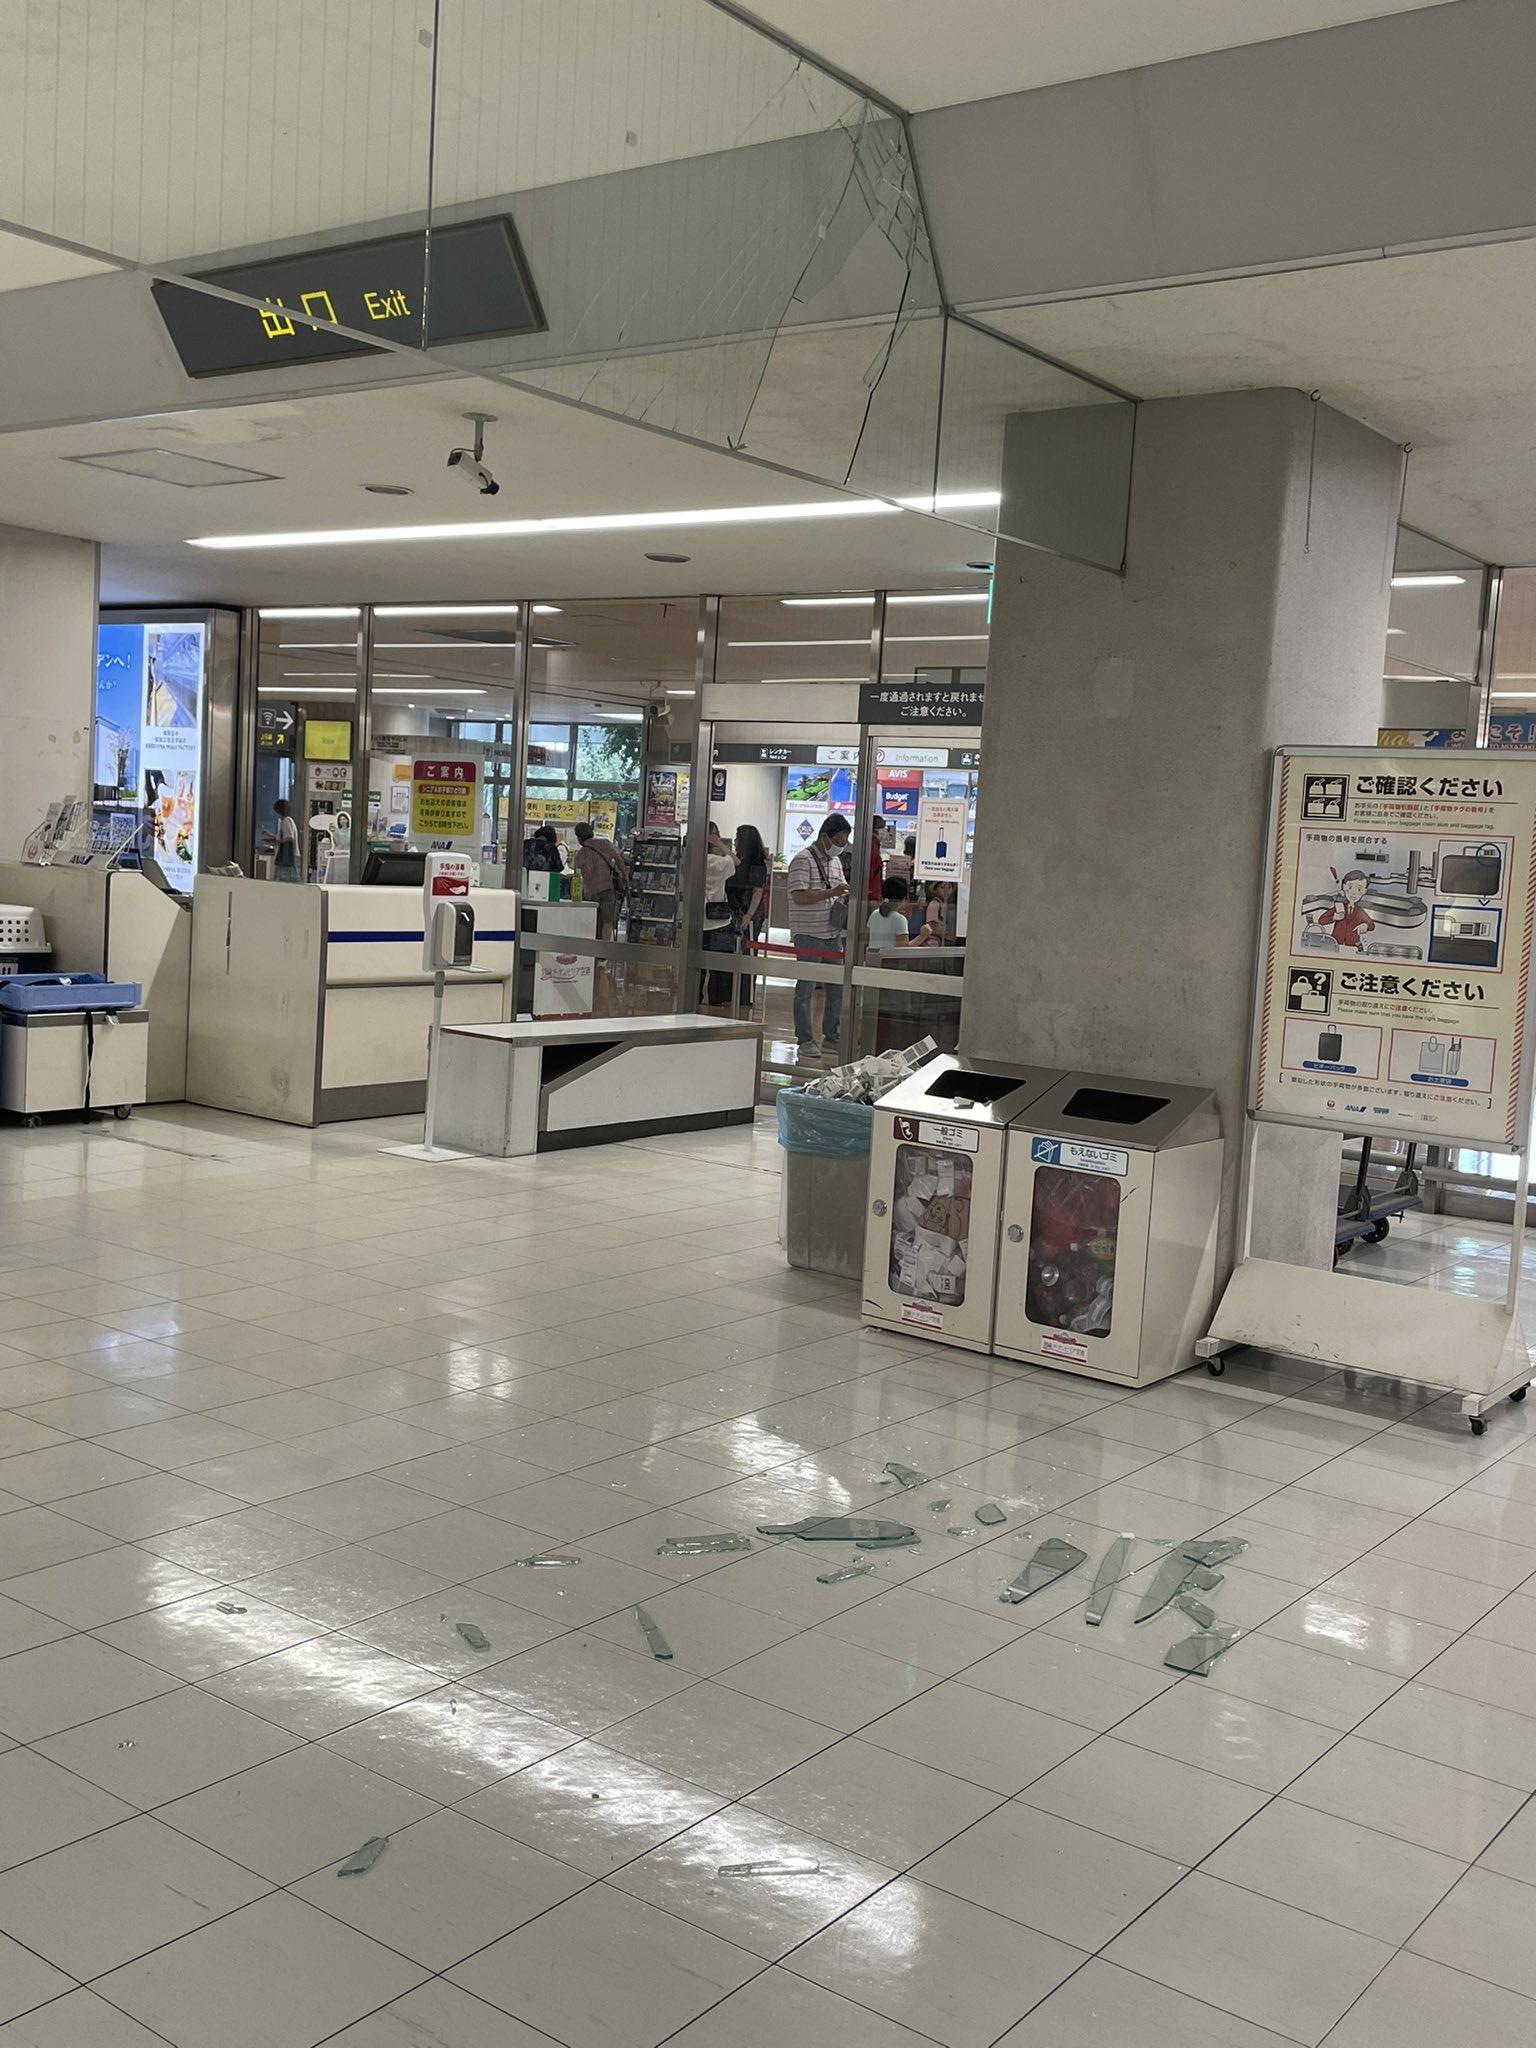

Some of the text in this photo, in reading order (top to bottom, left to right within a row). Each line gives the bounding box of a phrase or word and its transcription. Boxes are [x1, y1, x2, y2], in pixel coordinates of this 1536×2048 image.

[364, 289, 411, 320] Exit
[259, 290, 338, 339] 出口
[900, 706, 967, 717] ご注意ください。
[427, 765, 464, 779] ご案内
[888, 769, 908, 778] AVIS
[1357, 776, 1502, 797] ご確認ください
[885, 792, 909, 801] Budget
[431, 841, 449, 849] ANA
[68, 855, 89, 864] ANA
[1340, 972, 1484, 1000] ご注意ください
[1401, 1012, 1414, 1020] have
[1344, 1105, 1362, 1113] ANA
[933, 1126, 963, 1138] 一般ゴミ
[1070, 1146, 1118, 1163] もえないゴミ
